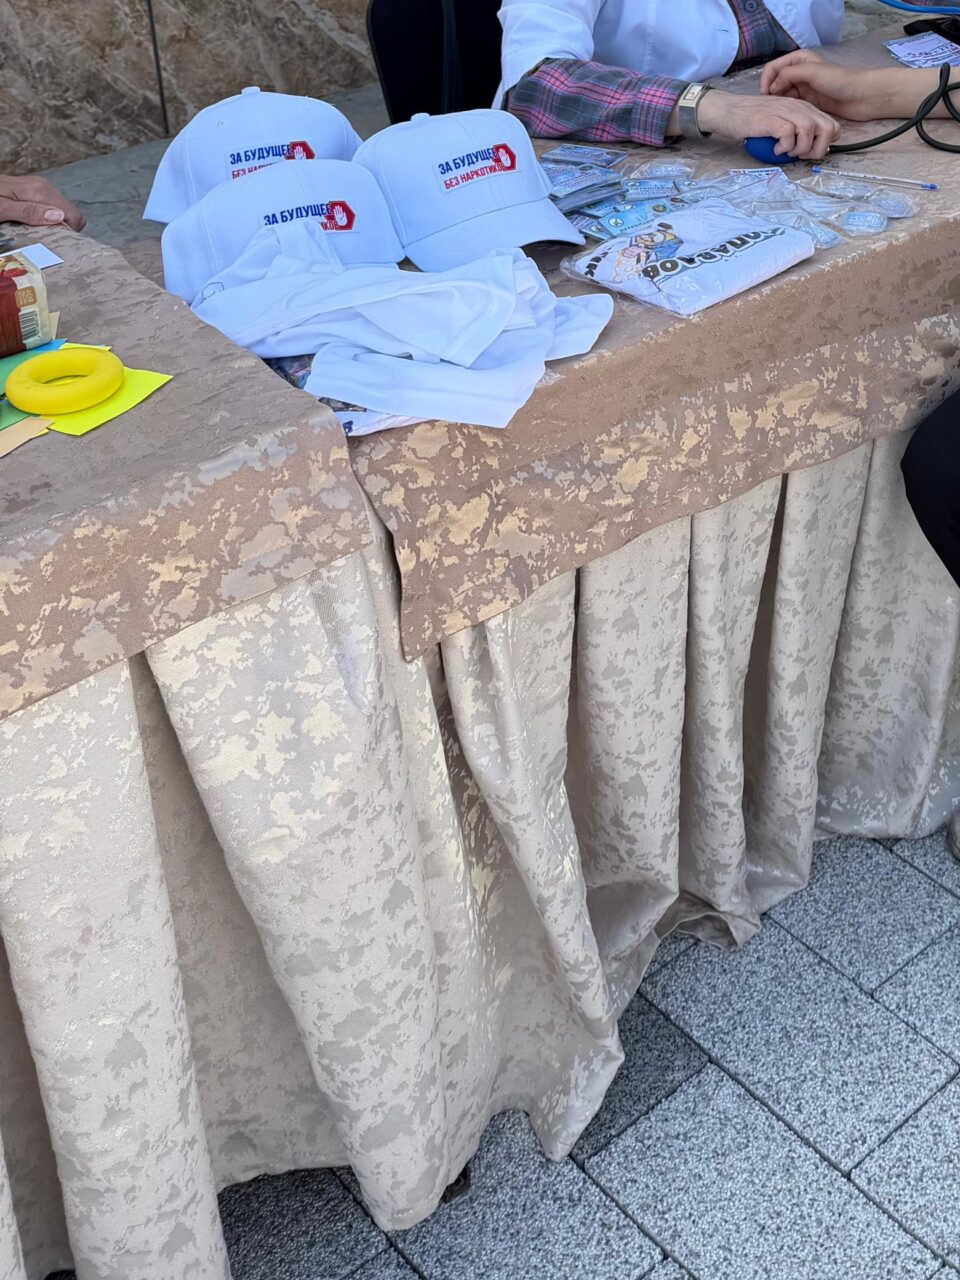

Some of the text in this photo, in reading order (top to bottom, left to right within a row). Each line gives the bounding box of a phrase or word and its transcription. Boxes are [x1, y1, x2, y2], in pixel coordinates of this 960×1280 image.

[229, 152, 243, 165] ЗА
[438, 147, 500, 175] ЗА БУДУЩЕЕ
[443, 176, 460, 190] БЕЗ
[263, 203, 332, 226] ЗА БУДУЩЕЕ
